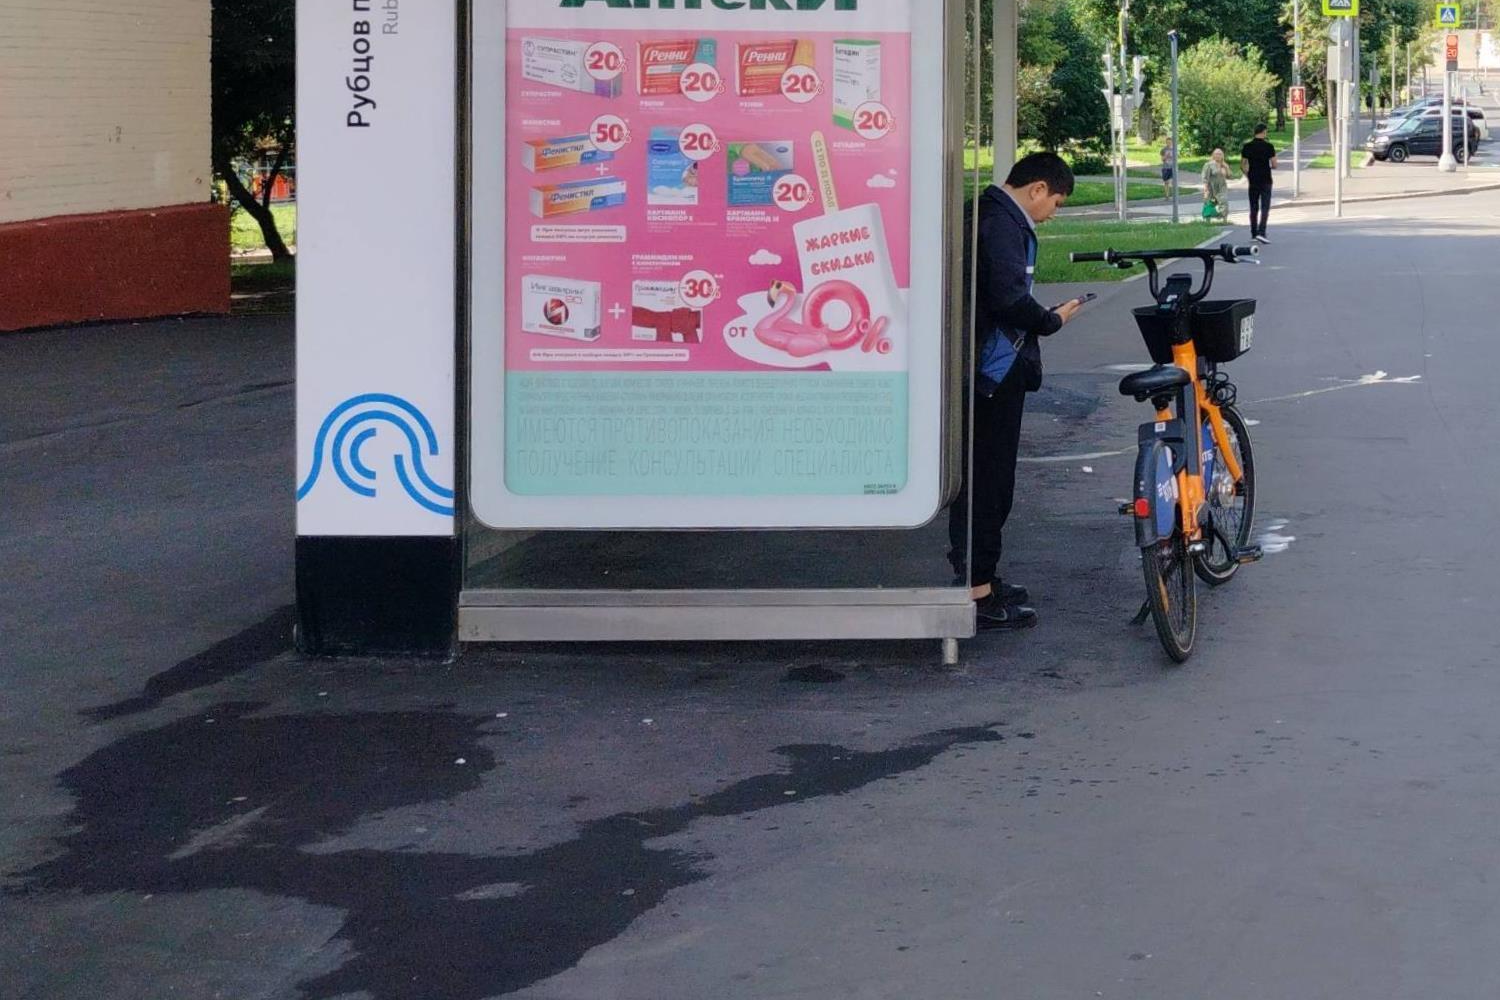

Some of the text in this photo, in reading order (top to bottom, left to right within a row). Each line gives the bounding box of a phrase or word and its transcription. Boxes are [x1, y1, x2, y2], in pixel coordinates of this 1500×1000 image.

[346, 20, 376, 128] Рубцов
[805, 226, 871, 252] ЖАРКИЕ
[810, 250, 876, 277] СКИДКИ
[516, 418, 597, 445] ИМЕЮТСЯ
[783, 418, 894, 447] НЕОБХОДИМО
[518, 450, 894, 478] ПОЛУЧЕНИЕ КОНСУЛЬТАЦИИ СПЕЦИАЛИСТА
